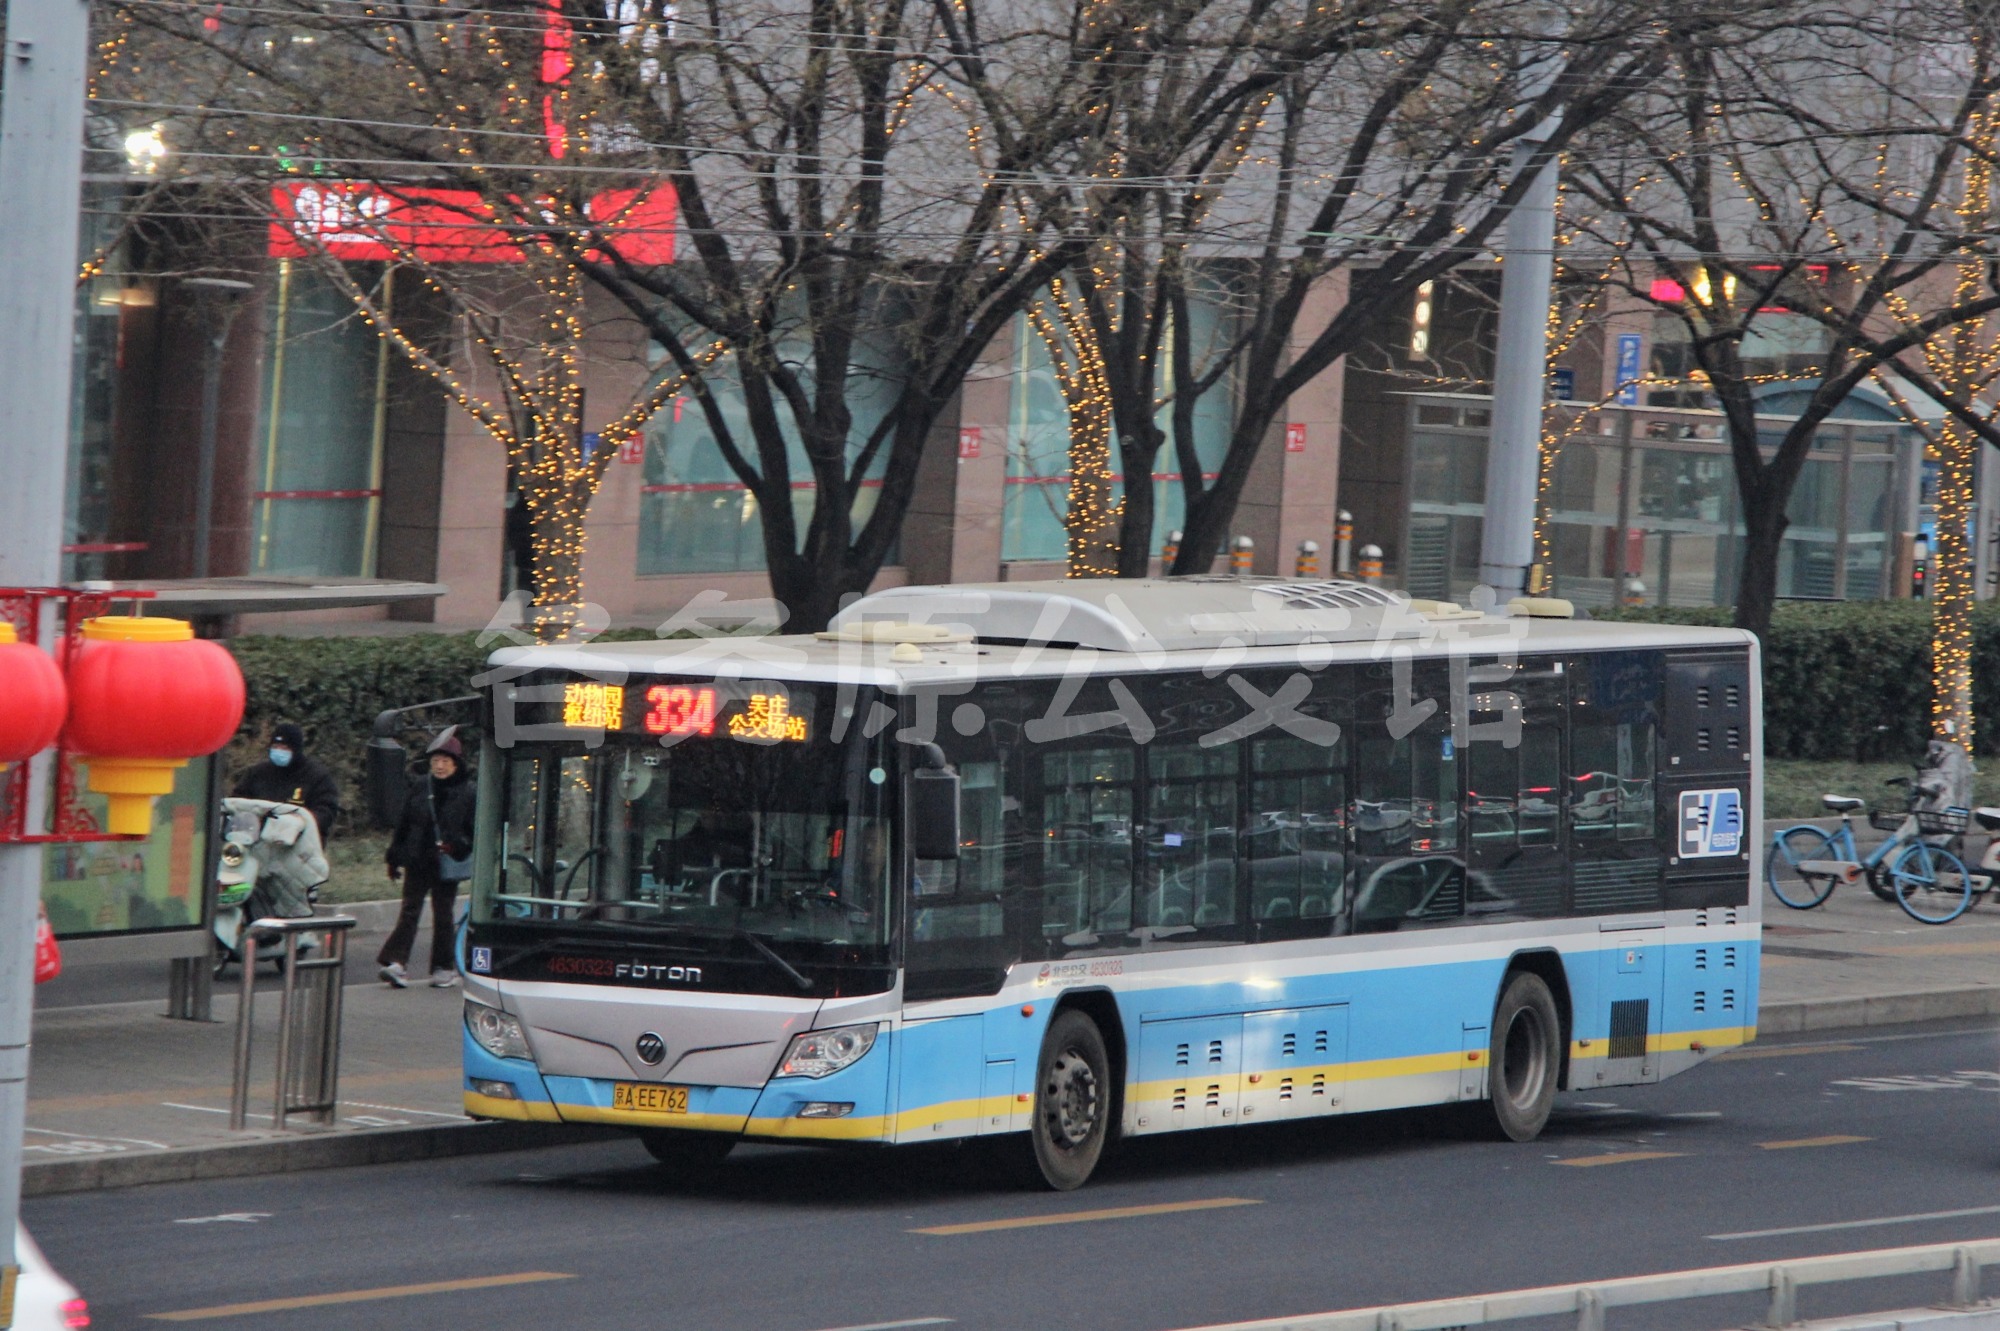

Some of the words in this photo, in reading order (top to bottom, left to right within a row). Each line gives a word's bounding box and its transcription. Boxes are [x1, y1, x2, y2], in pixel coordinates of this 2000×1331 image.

[564, 684, 624, 708] 动物园
[748, 694, 788, 716] 吴庄
[563, 703, 622, 730] 枢纽站
[646, 685, 715, 734] 334
[728, 713, 807, 741] 公交场站
[548, 957, 614, 976] 4630323
[615, 963, 702, 983] FOTON
